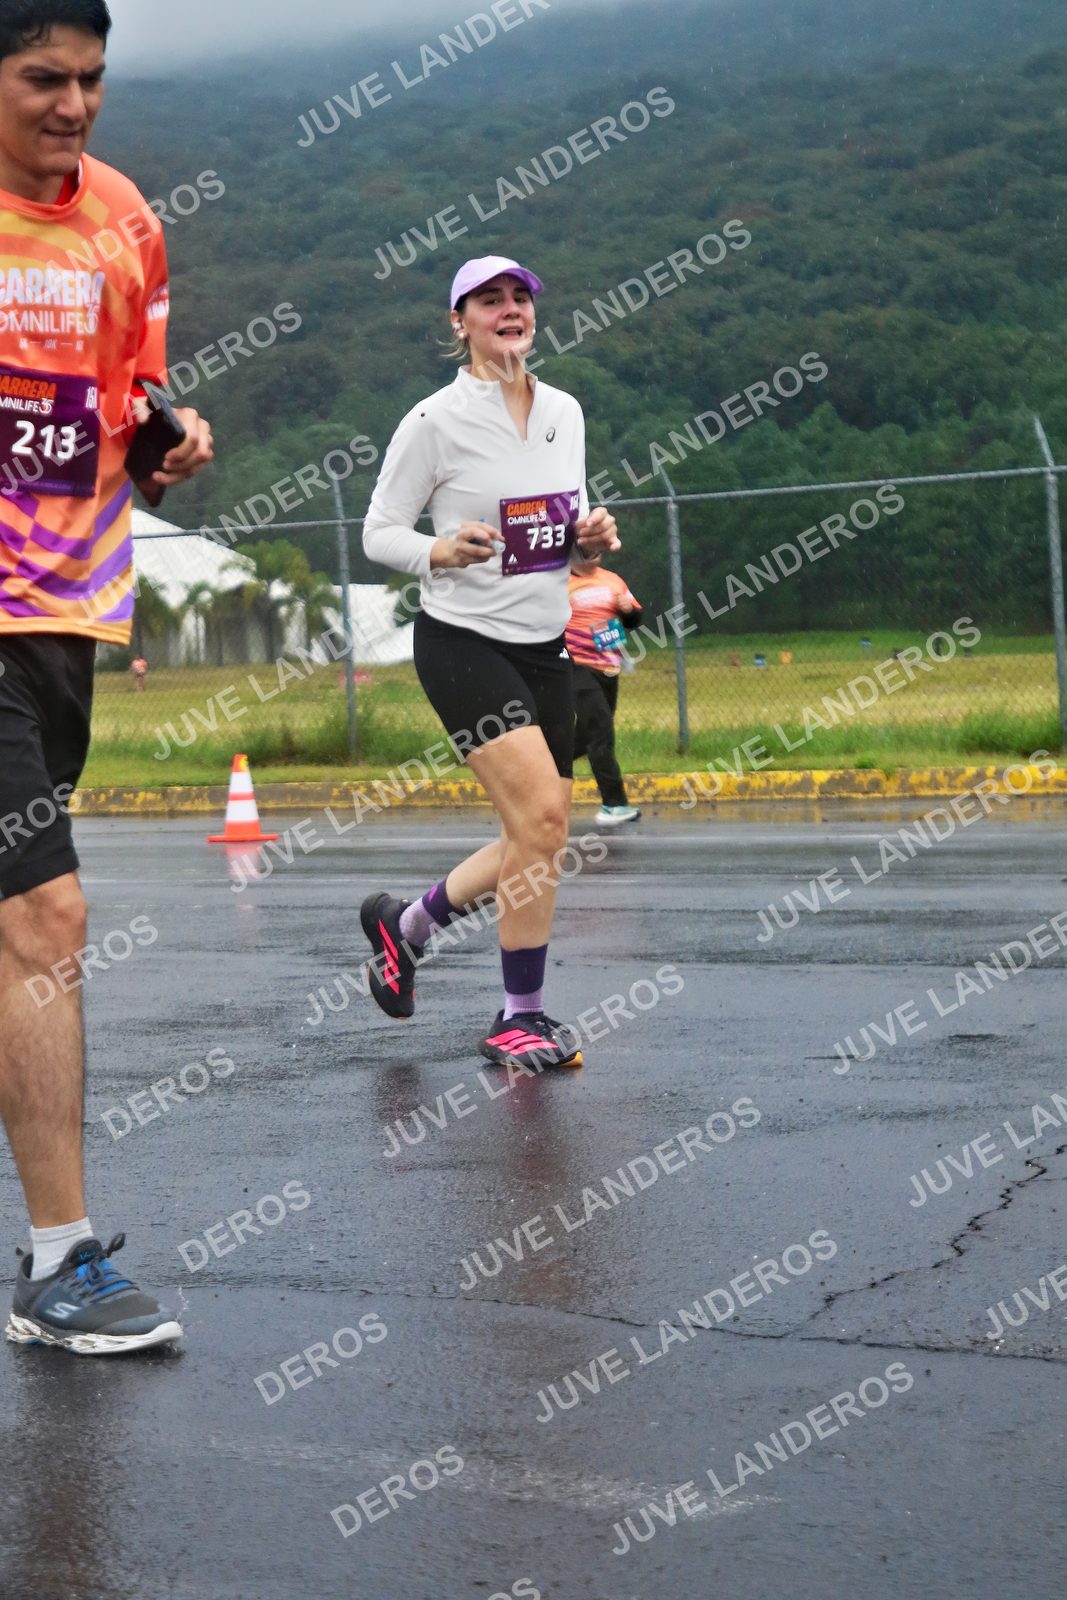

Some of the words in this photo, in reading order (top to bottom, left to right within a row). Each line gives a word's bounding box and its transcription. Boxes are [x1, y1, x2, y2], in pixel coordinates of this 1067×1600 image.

[12, 420, 76, 459] 213
[507, 500, 547, 516] CARRERA
[527, 524, 566, 550] 733
